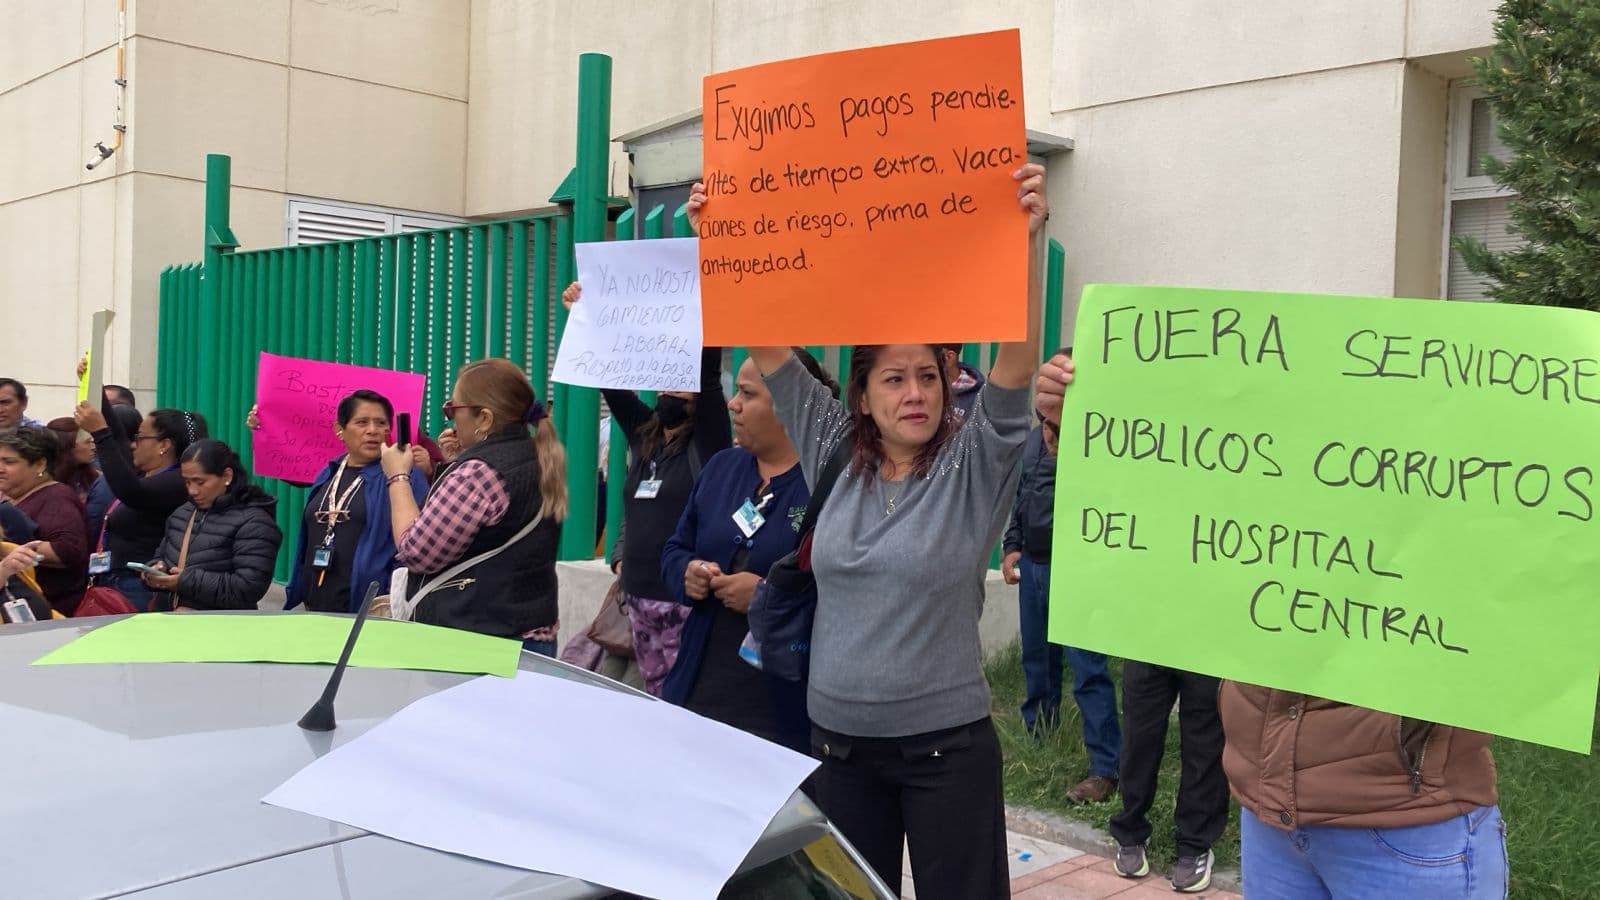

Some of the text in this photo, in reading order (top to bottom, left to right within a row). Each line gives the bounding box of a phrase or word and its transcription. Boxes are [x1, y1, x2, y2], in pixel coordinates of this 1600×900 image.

[714, 84, 816, 151] Exigimos
[840, 91, 914, 138] pagos
[703, 168, 738, 196] ntes
[749, 168, 779, 194] de
[783, 163, 863, 194] tiempo
[700, 210, 747, 241] ciones
[753, 213, 779, 236] de
[865, 202, 929, 231] prima
[941, 192, 978, 214] de
[598, 263, 619, 298] YA
[596, 304, 685, 328] GAMIENTO
[1101, 304, 1290, 372] FUERA
[611, 332, 692, 357] LABORAL
[272, 369, 350, 399] Bast
[1082, 411, 1595, 522] PUBLICOS CORRUPTOS
[1080, 507, 1403, 580] DEL HOSPITAL
[1249, 580, 1470, 655] CENTRAL
